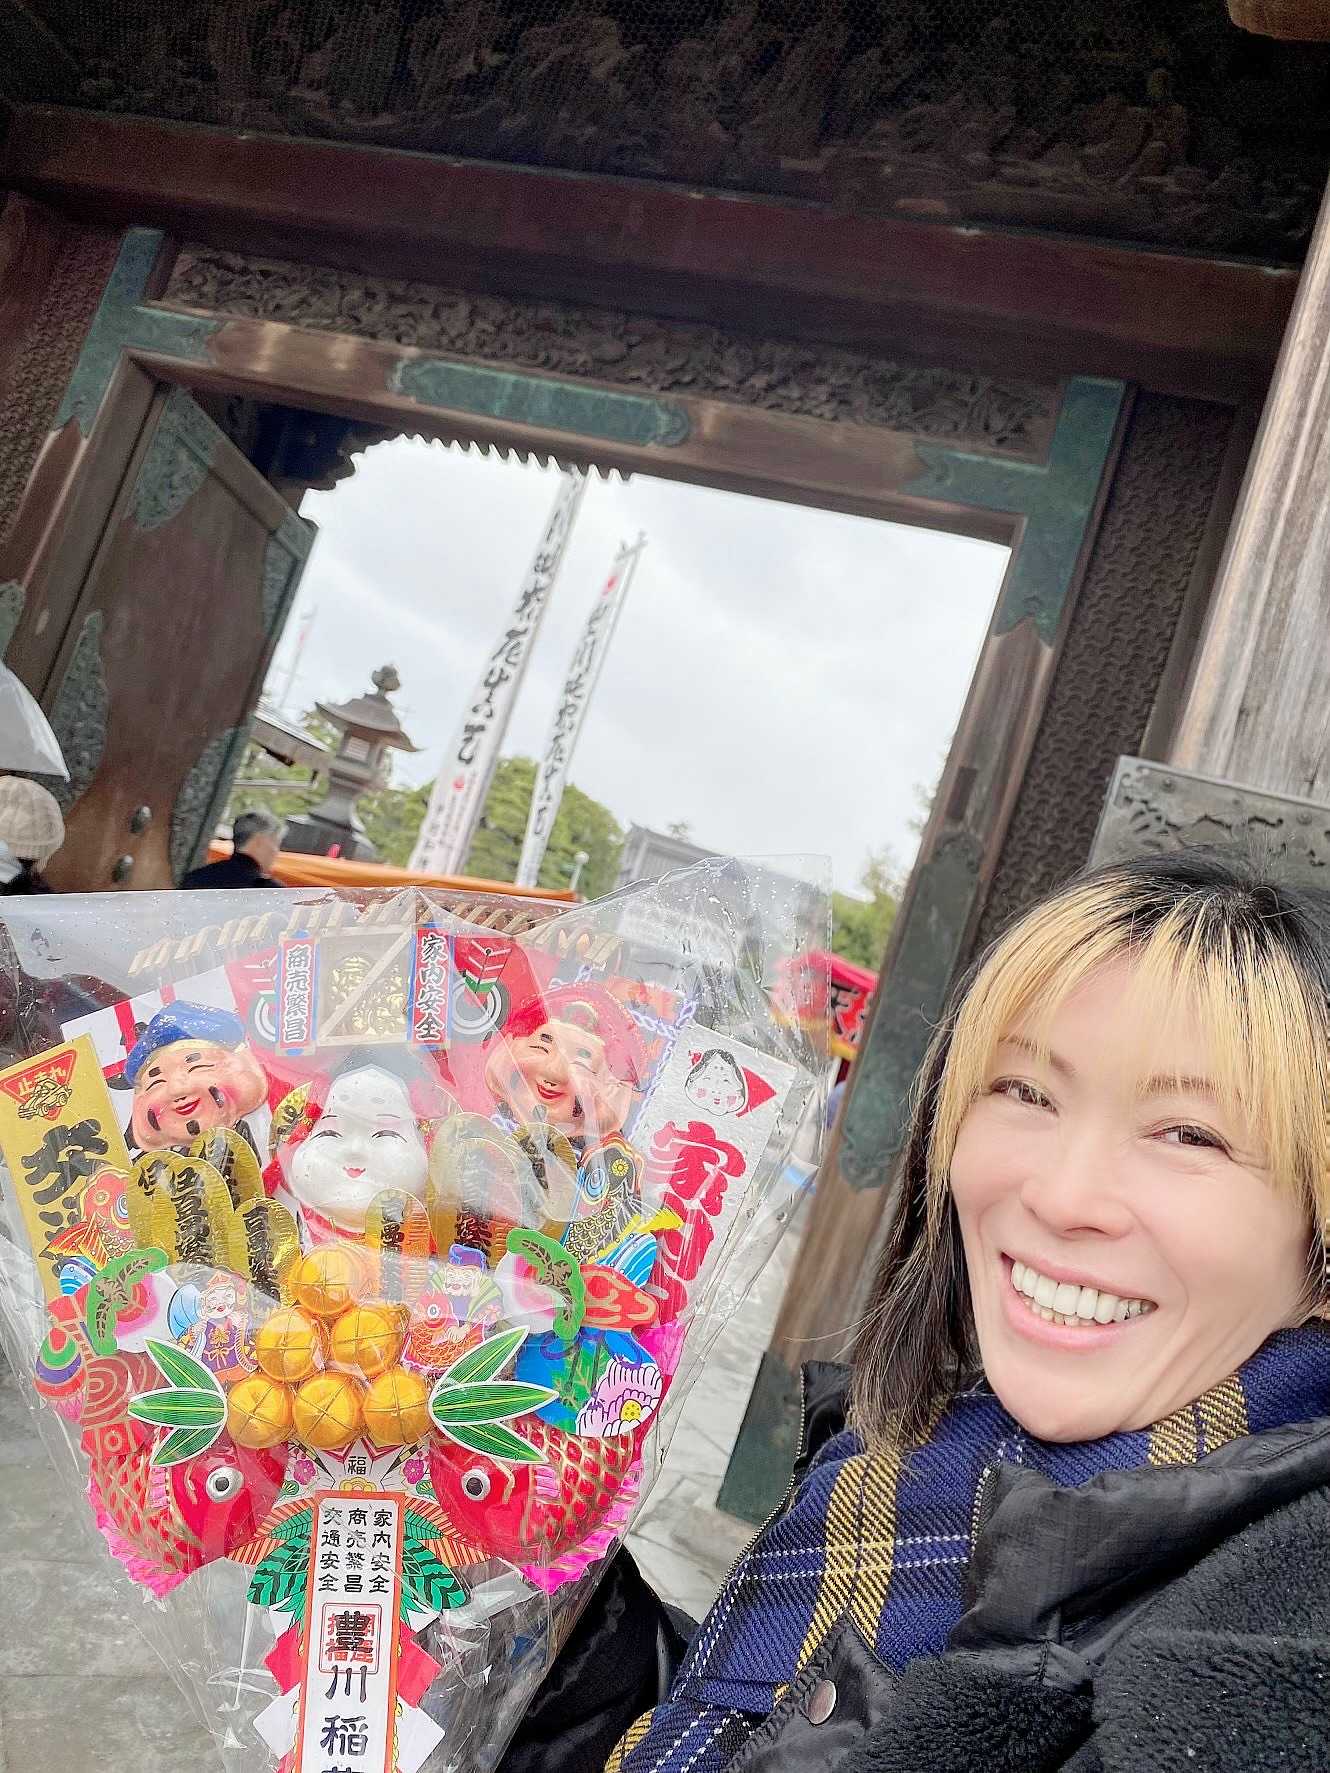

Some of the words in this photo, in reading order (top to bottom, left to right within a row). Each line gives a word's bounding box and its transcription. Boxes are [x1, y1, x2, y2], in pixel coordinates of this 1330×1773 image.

[417, 934, 448, 1041] 家内安全
[347, 1455, 367, 1475] 福
[318, 1507, 342, 1591] 交通安全
[344, 1508, 368, 1592] 商売繁昌
[369, 1509, 393, 1593] 家内安全
